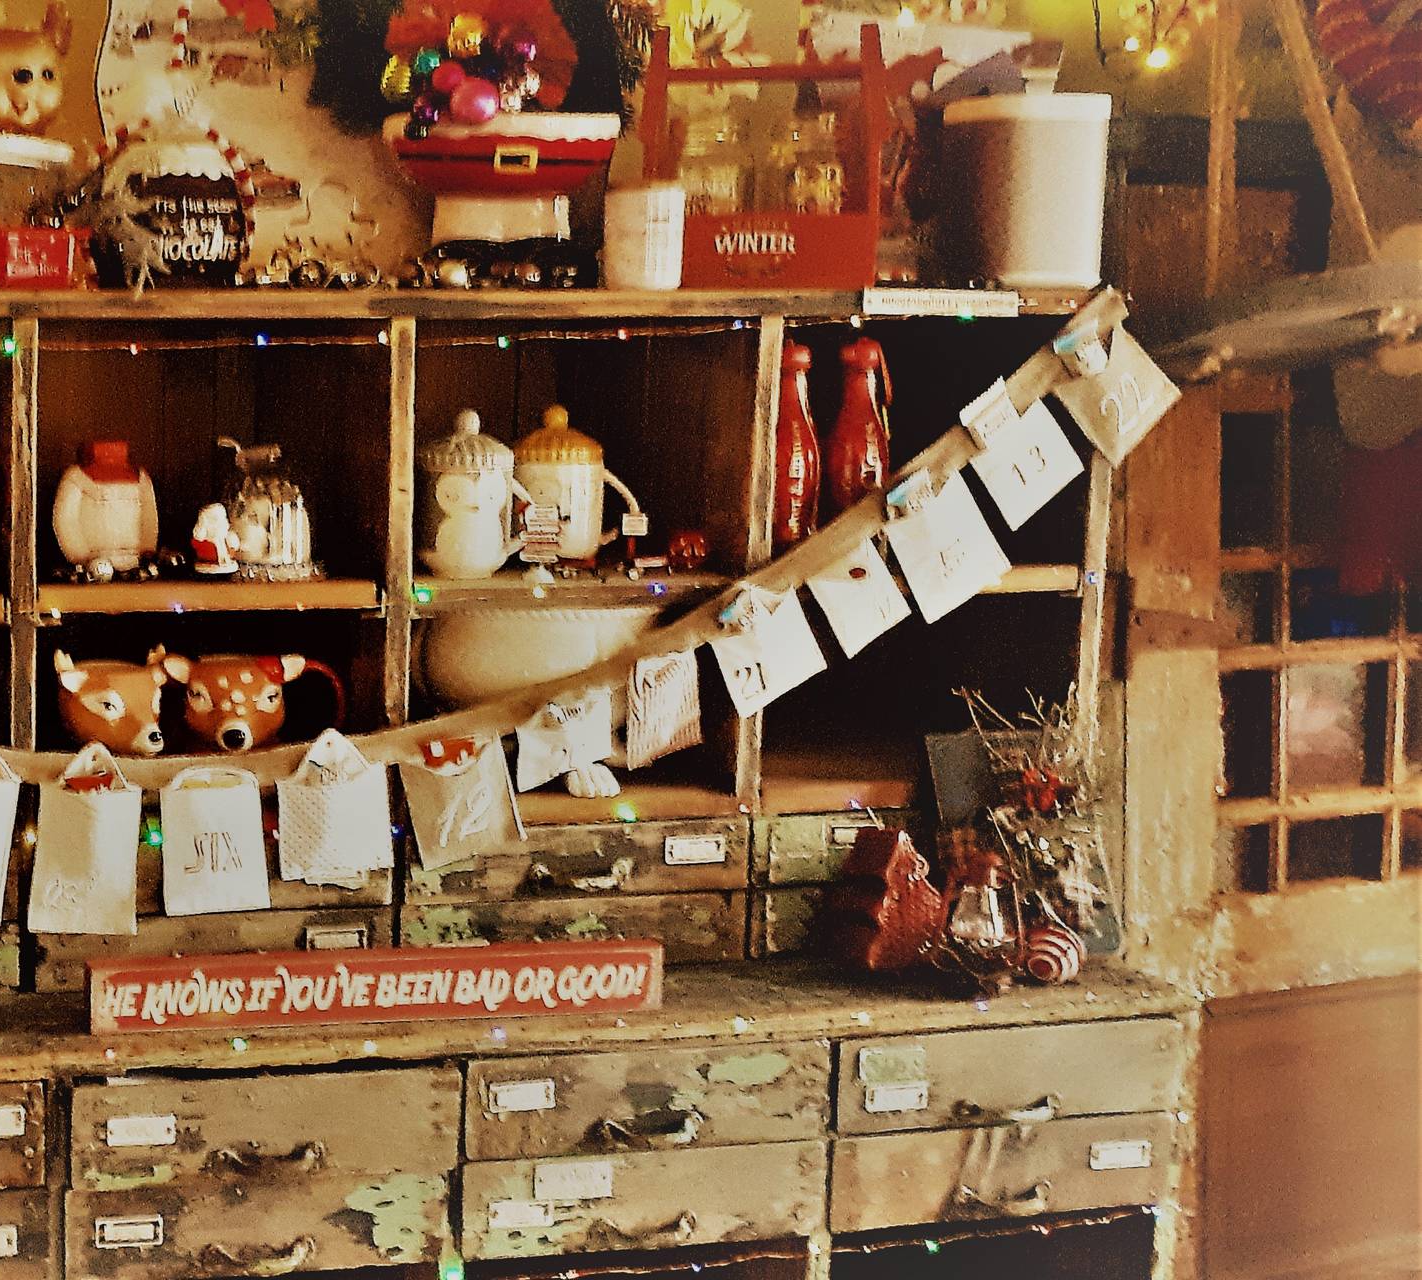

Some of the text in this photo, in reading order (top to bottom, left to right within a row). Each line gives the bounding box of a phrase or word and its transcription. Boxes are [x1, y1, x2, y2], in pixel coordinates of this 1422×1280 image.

[714, 231, 797, 257] WINTER
[1011, 444, 1048, 487] 13
[733, 661, 767, 701] 21
[439, 784, 494, 849] 12
[183, 831, 244, 874] SIX
[99, 981, 142, 1018] HE
[140, 967, 247, 1026] KNOWS
[245, 976, 282, 1013] IF
[374, 969, 454, 1009] BEEN
[453, 966, 512, 1013] BAD
[513, 965, 558, 1009] OR
[555, 962, 651, 1008] GOOD!
